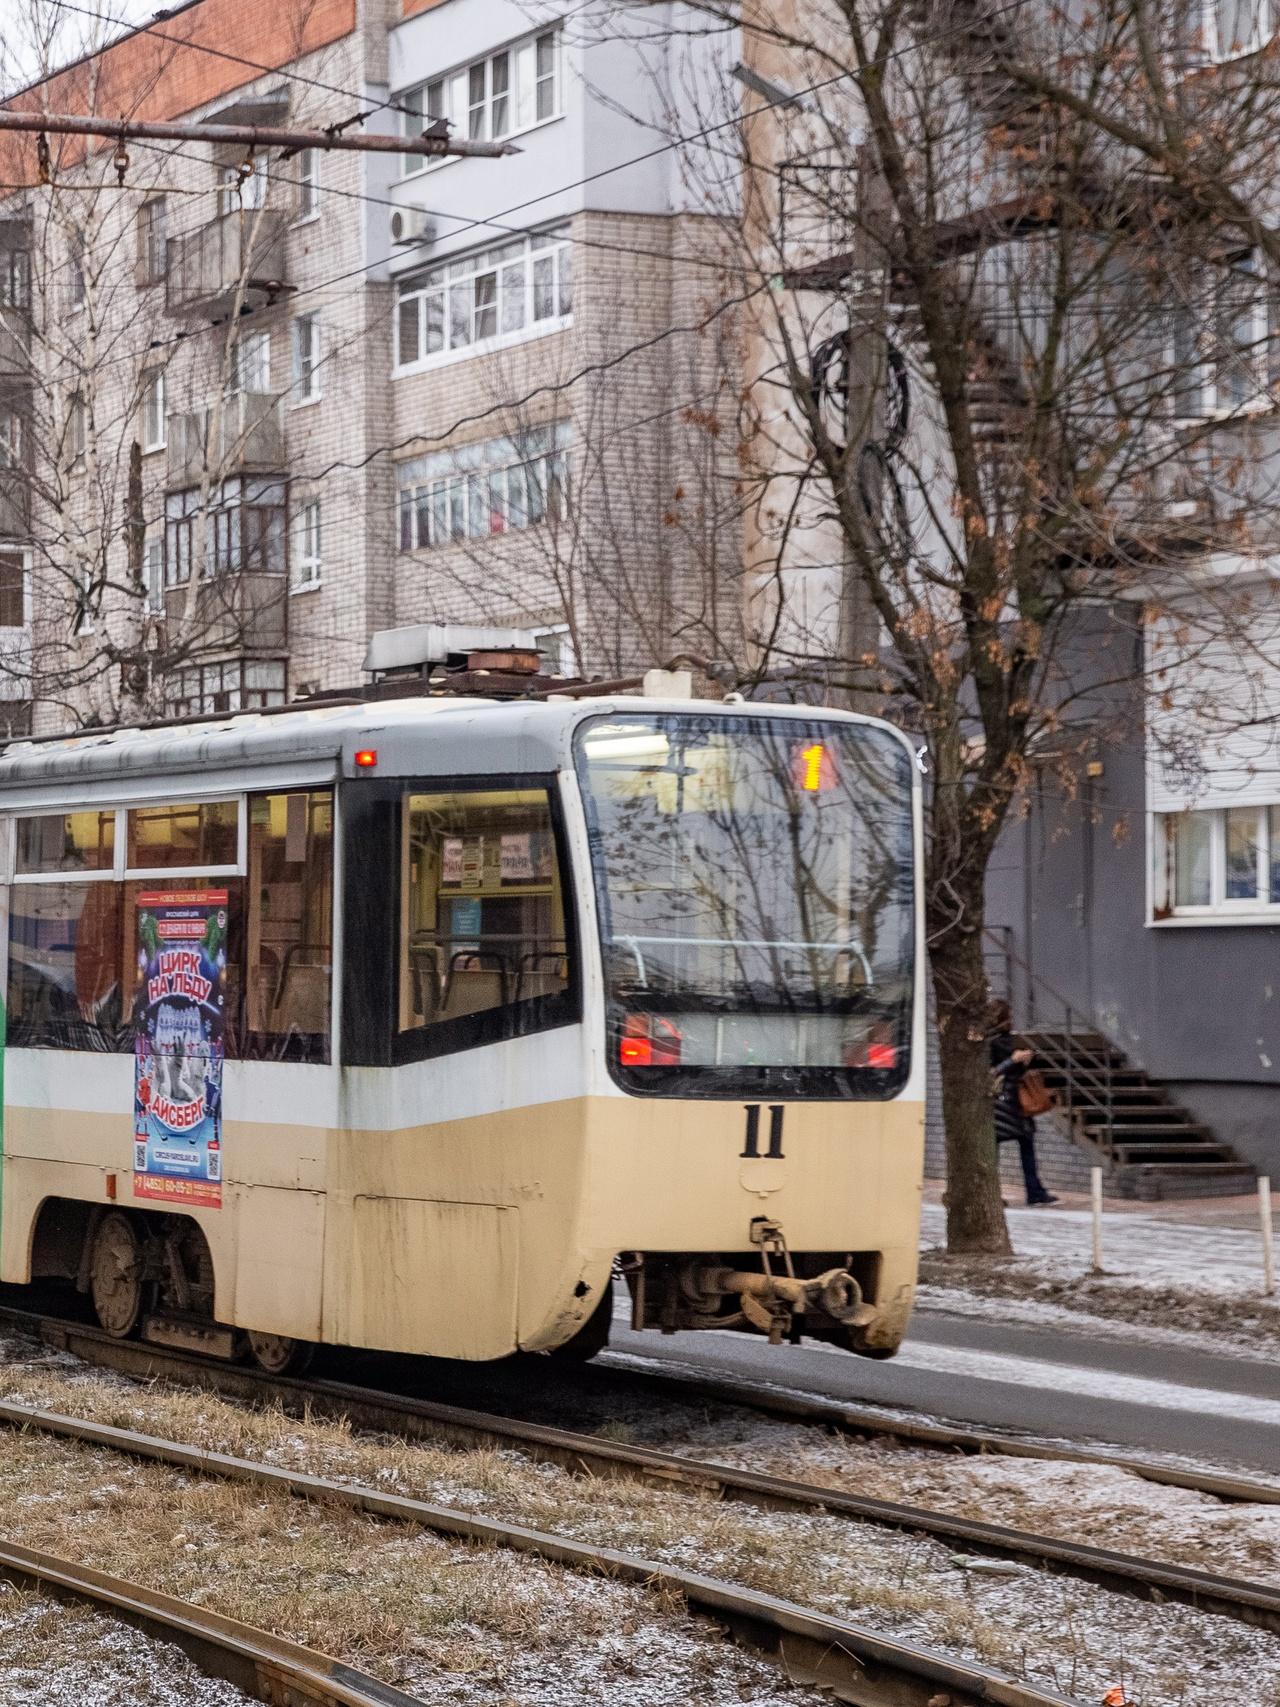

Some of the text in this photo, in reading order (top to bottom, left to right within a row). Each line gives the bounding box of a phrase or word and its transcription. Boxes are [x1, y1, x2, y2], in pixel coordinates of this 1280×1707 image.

[802, 744, 823, 791] 1
[160, 951, 200, 976] ЦИРК
[149, 973, 211, 1002] НА ЛЬДУ
[152, 1094, 204, 1127] АЙСБЕРГ
[739, 1104, 785, 1159] 11
